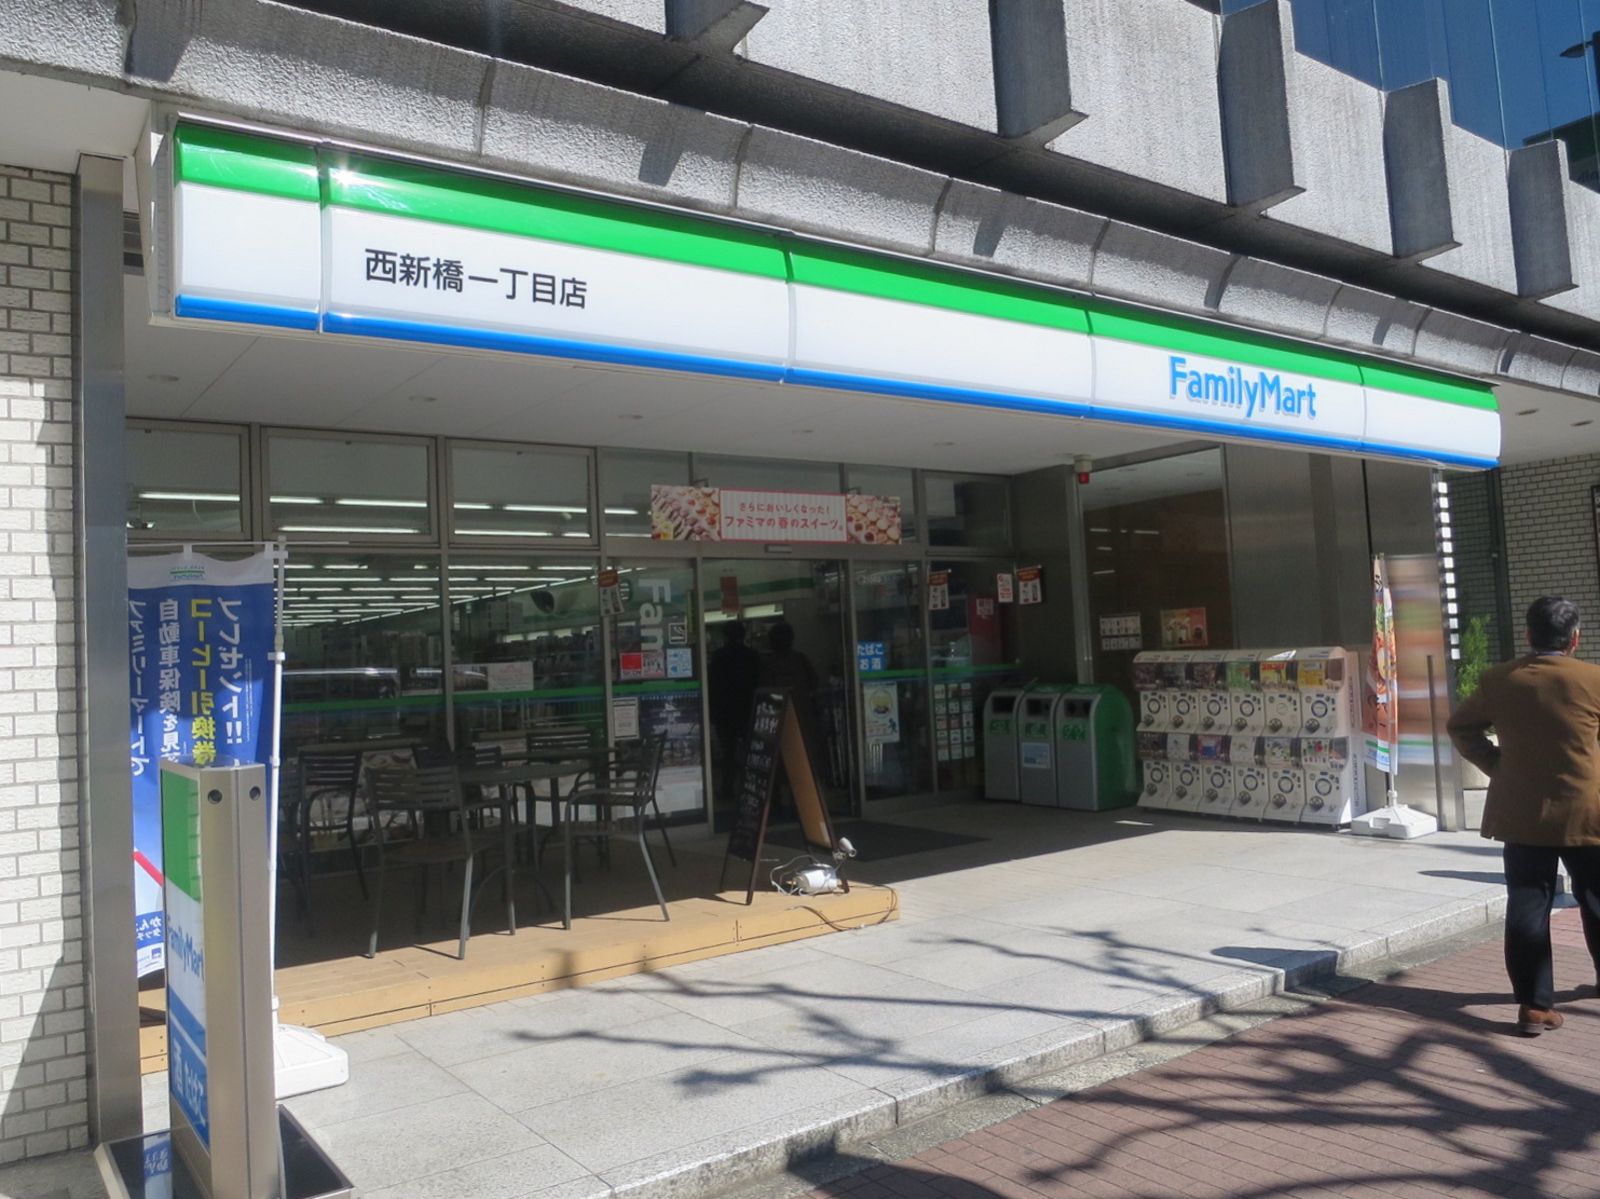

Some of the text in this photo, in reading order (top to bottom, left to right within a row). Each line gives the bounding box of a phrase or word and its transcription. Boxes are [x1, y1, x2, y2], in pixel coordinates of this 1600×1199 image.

[365, 248, 587, 309] 西新橋一丁目店
[1168, 355, 1317, 418] FamilyMart
[857, 642, 884, 656] たばこ
